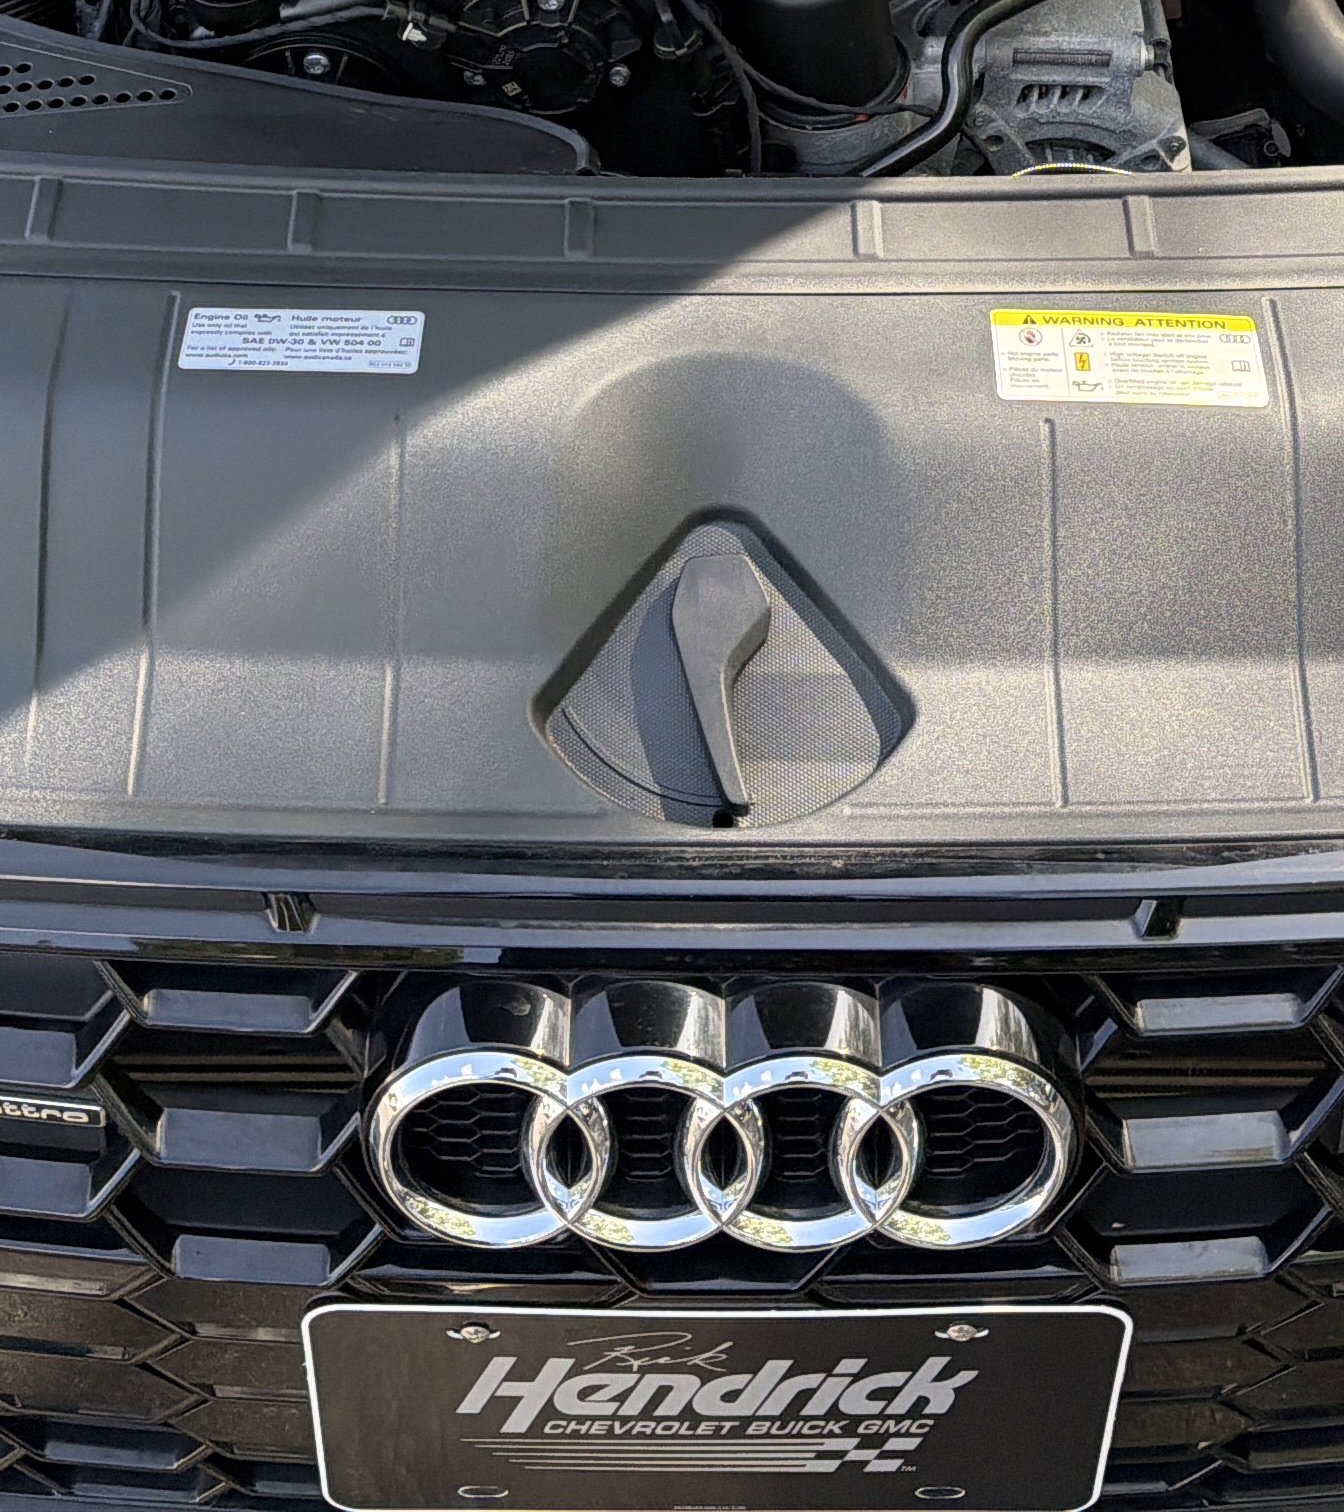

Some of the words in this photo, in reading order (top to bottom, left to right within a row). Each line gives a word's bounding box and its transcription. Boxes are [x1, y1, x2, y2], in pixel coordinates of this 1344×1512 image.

[193, 313, 231, 322] Engine
[233, 313, 249, 321] Oil
[291, 315, 318, 323] Huile
[1042, 316, 1125, 326] WARNING
[1134, 318, 1227, 329] ATTENTION
[242, 337, 266, 345] SAE
[308, 338, 317, 346] &
[320, 339, 341, 347] VW
[343, 339, 365, 347] 504
[367, 339, 382, 347] 00
[456, 1355, 980, 1434] Hendrick
[542, 1419, 740, 1436] CHEVROLET
[745, 1419, 850, 1435] BUICK
[856, 1418, 936, 1434] GMC
